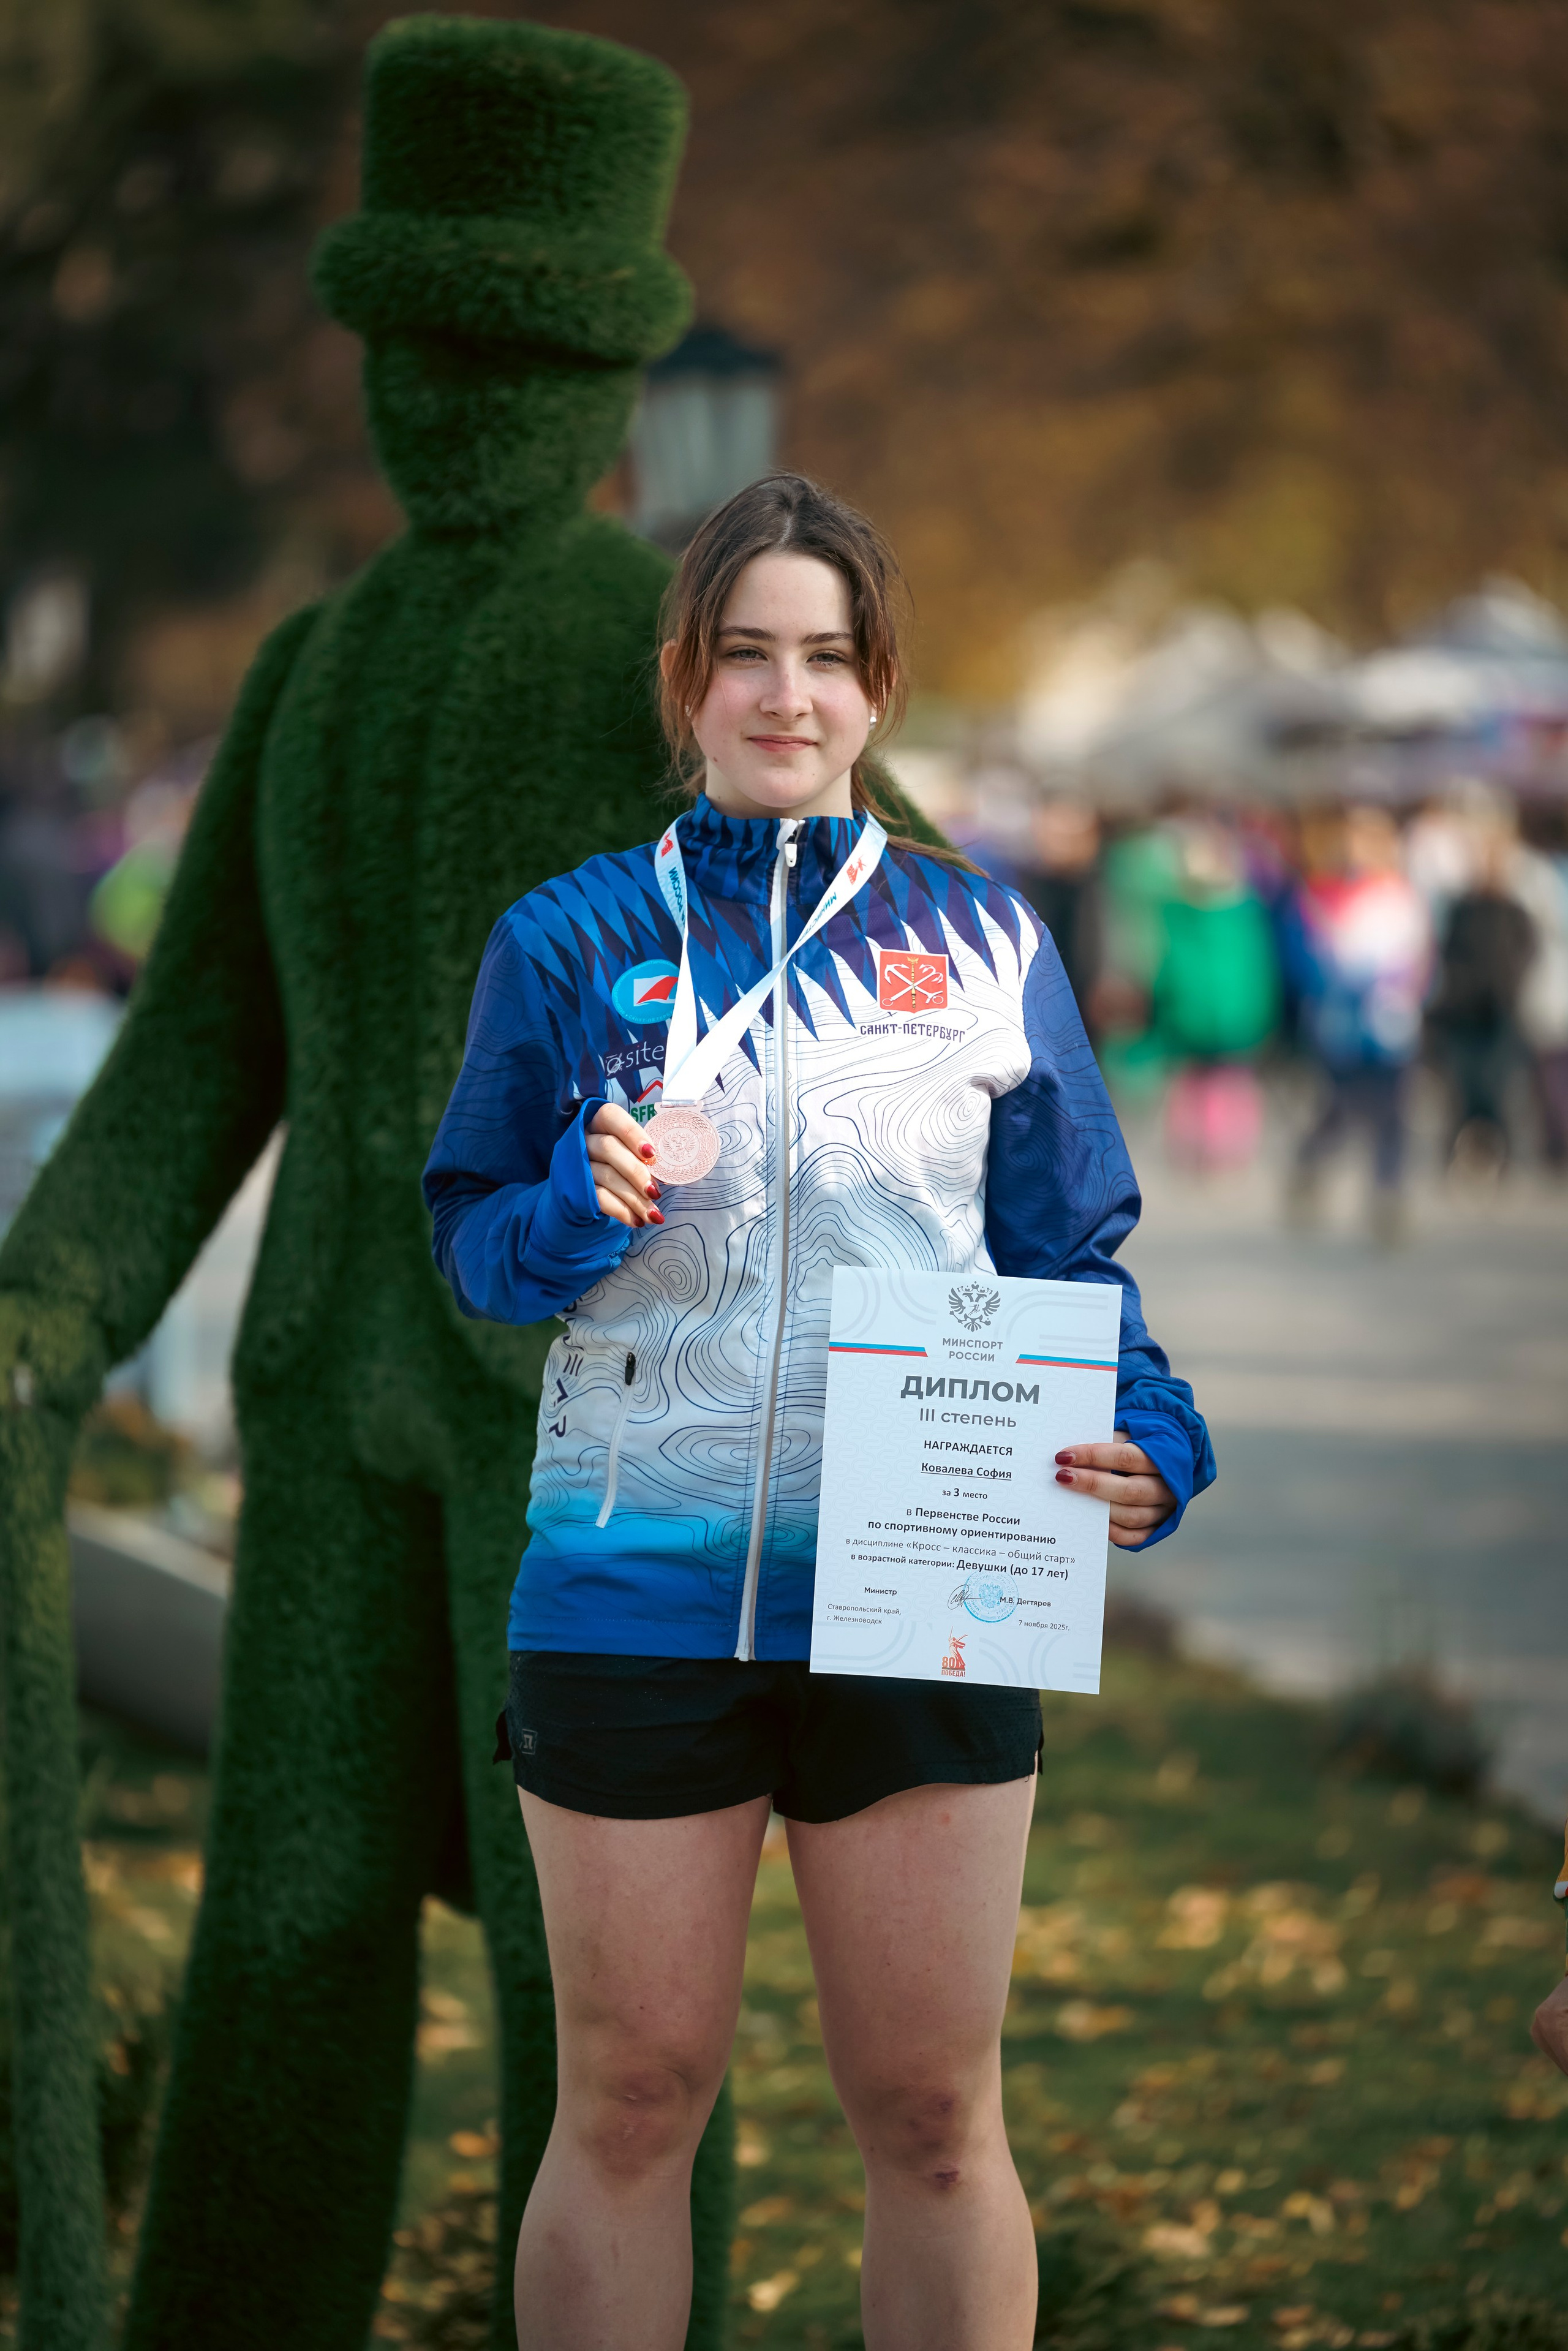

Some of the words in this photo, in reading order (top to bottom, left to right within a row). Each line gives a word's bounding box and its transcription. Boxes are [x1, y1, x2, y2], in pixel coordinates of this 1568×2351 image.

[861, 1024, 965, 1043] САНКТ-ПЕТЕРБУРГ
[942, 1337, 1003, 1350] МИНСПОРТ
[949, 1351, 995, 1362] РОССИИ
[900, 1375, 1040, 1405] ДИПЛОМ
[941, 1412, 1017, 1428] степень
[924, 1440, 1012, 1456] НАГРАЖДАЕТСЯ
[921, 1462, 973, 1476] Ковалева
[977, 1467, 1012, 1479] София
[953, 1487, 960, 1497] 3
[915, 1508, 979, 1522] Первенстве
[982, 1513, 1020, 1525] России
[884, 1522, 958, 1538] спортивному
[960, 1529, 1056, 1545] ориентированию
[851, 1539, 903, 1549] дисциплине
[906, 1541, 941, 1552] «Кросс
[952, 1546, 997, 1557] классика
[1008, 1550, 1041, 1561] общий
[1044, 1555, 1076, 1565] старт»
[858, 1555, 907, 1564] возрастной
[908, 1558, 955, 1568] категории:
[957, 1560, 1007, 1572] Девушки
[1010, 1563, 1028, 1576] (до
[1031, 1566, 1044, 1576] 17
[1046, 1569, 1068, 1581] лет)
[864, 1587, 897, 1596] Министр
[1000, 1596, 1015, 1604] М.В.
[1016, 1598, 1051, 1608] Дегтярев
[827, 1603, 882, 1613] Ставропольский
[883, 1607, 902, 1616] край,
[833, 1615, 882, 1625] Железноводск
[1049, 1623, 1070, 1631] 2025г.
[942, 1656, 956, 1668] 80
[941, 1669, 966, 1678] ПОБЕДА!
